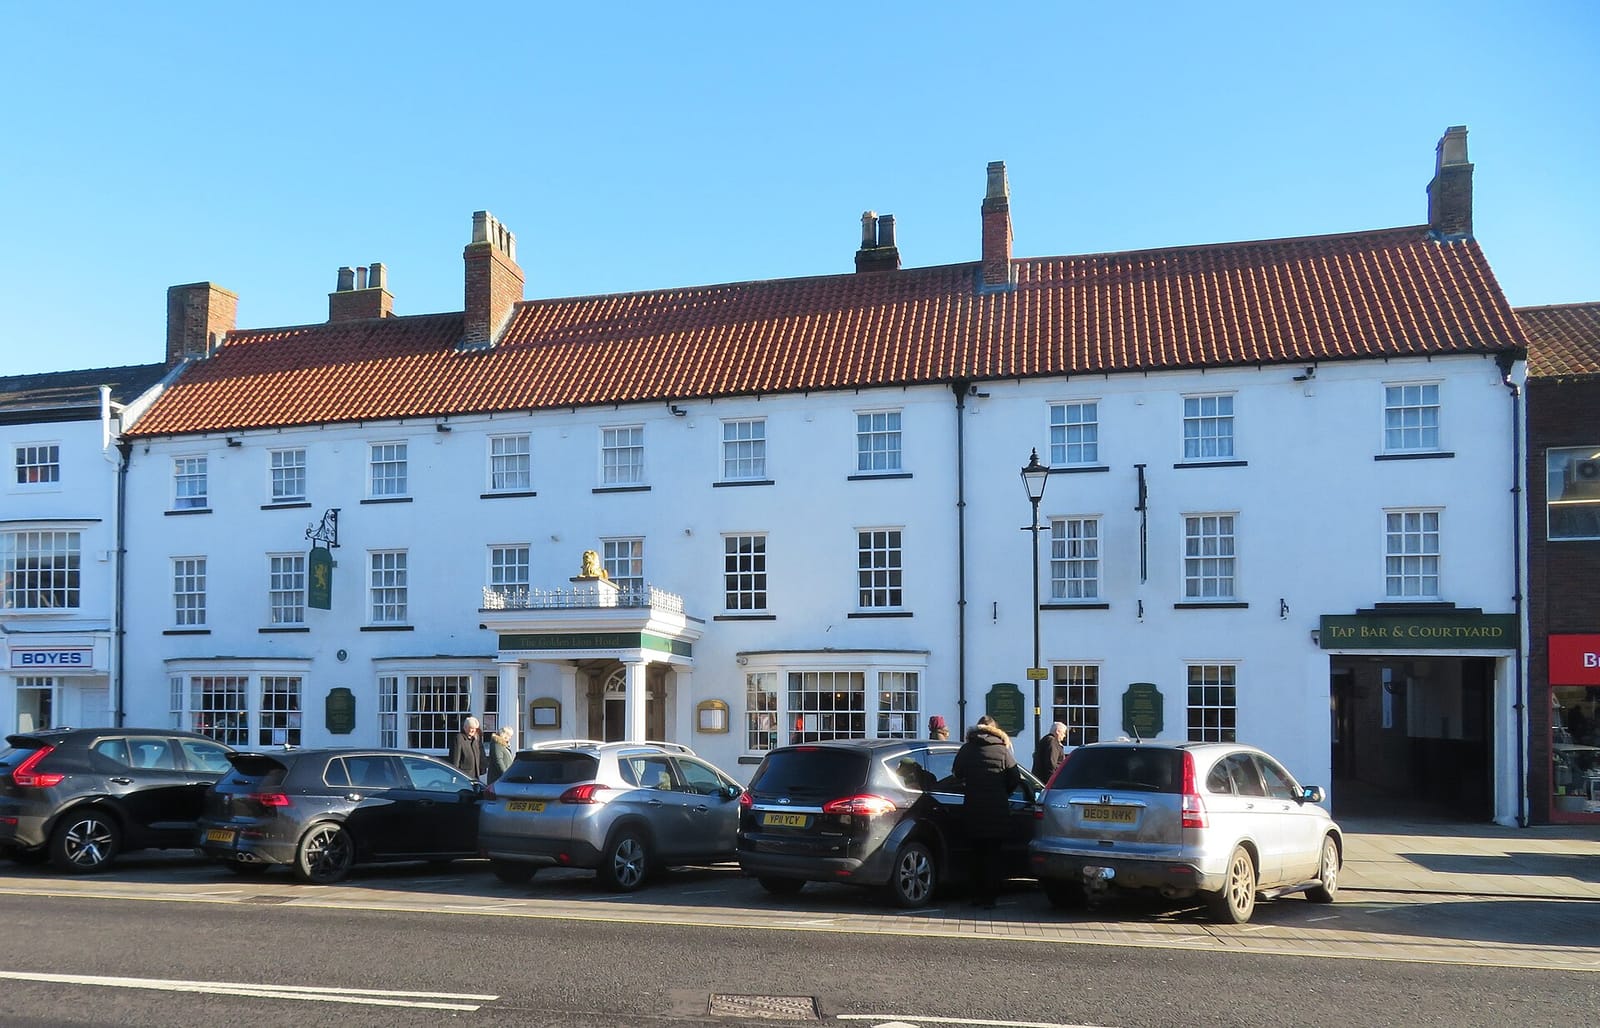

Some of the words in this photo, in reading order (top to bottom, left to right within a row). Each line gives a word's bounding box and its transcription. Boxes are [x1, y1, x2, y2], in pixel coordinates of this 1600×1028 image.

[1392, 626, 1403, 637] &
[520, 637, 537, 647] The
[539, 637, 570, 647] Golden
[572, 637, 592, 647] Lion
[594, 636, 620, 646] Hotel
[22, 652, 82, 664] BOYES
